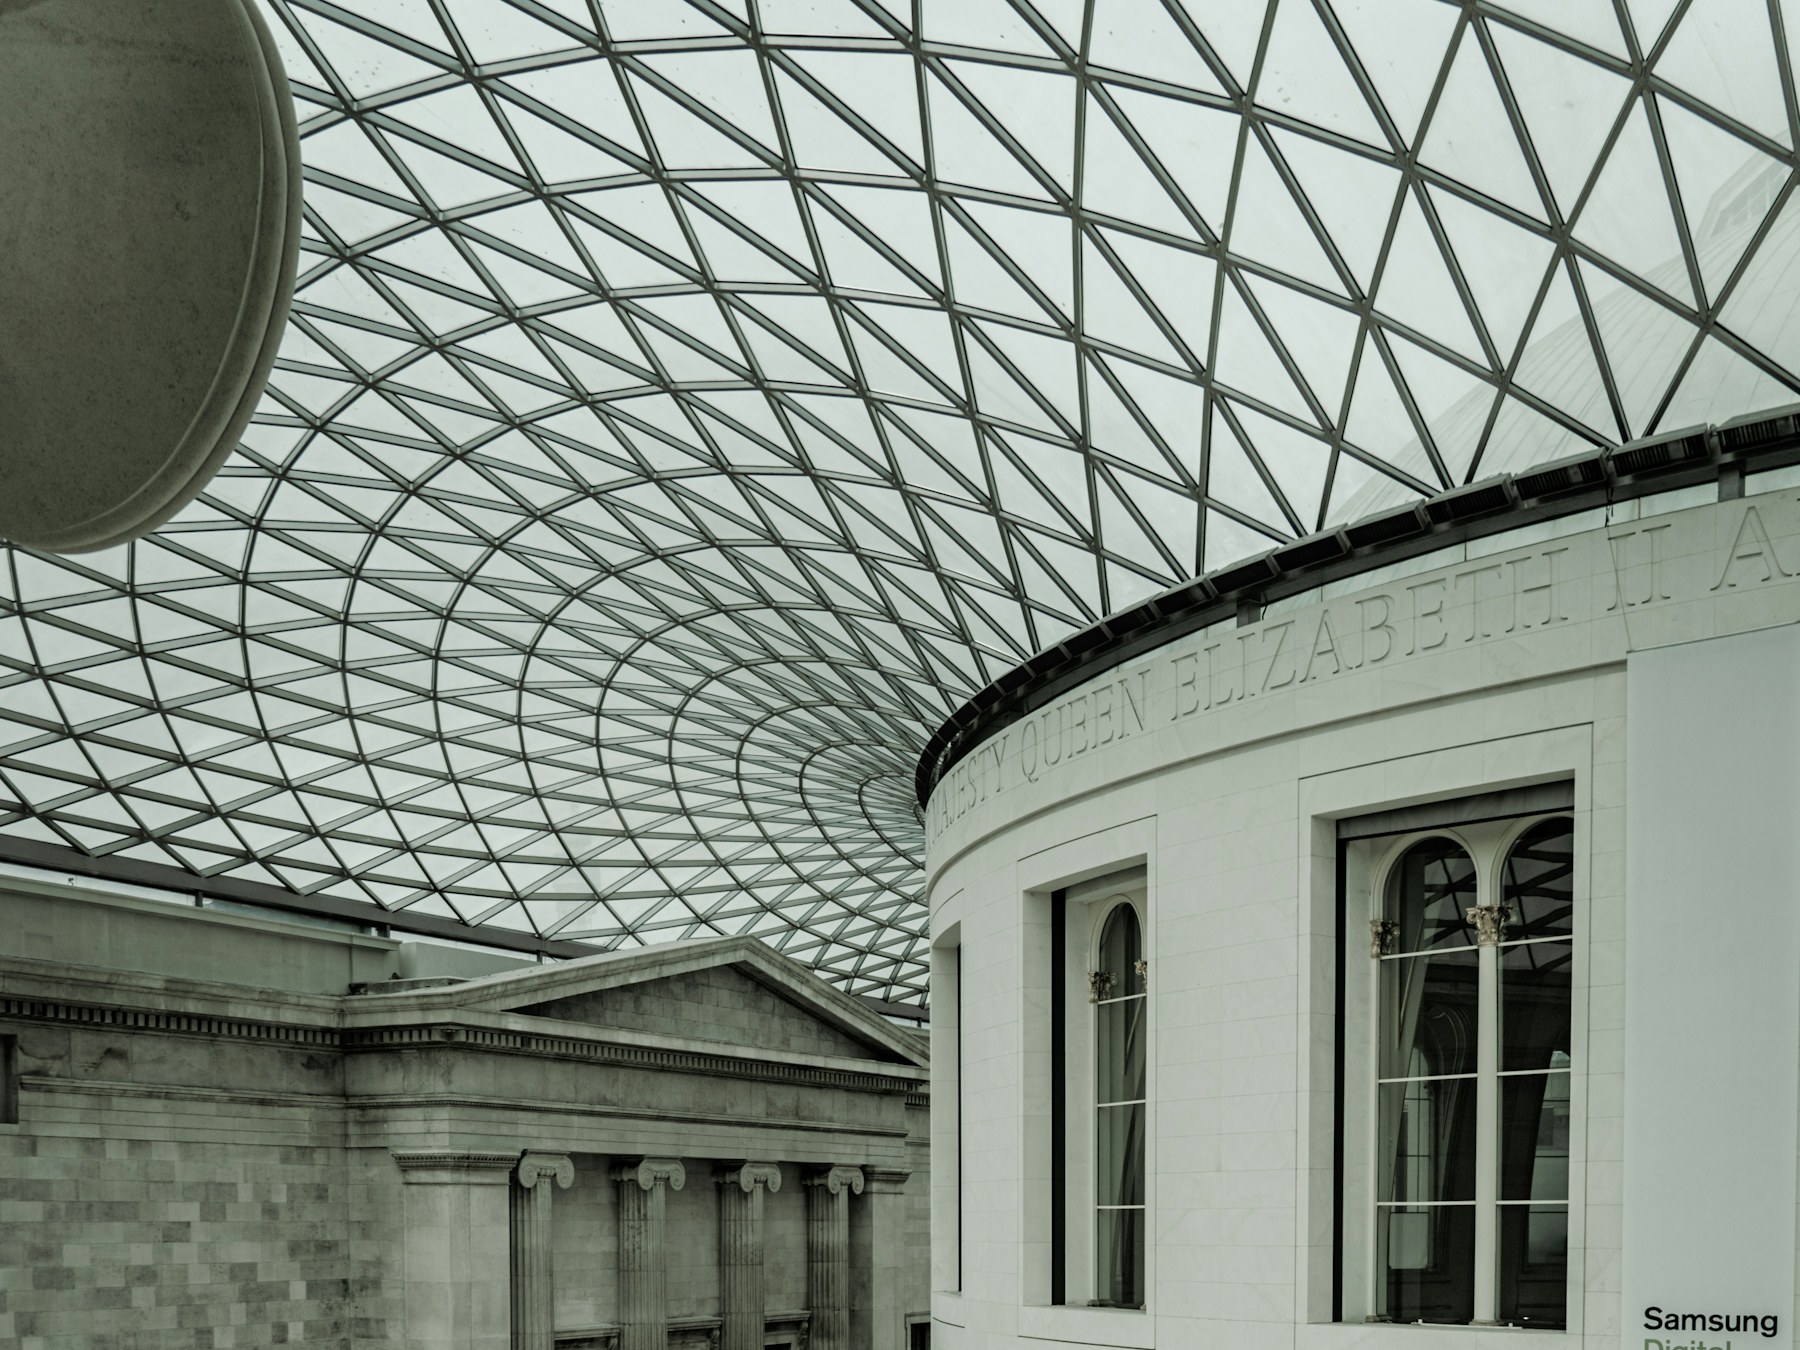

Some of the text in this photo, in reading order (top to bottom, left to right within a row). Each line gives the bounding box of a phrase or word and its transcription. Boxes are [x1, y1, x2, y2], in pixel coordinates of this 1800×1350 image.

[1021, 669, 1151, 783] QUEEN
[1171, 547, 1569, 721] ELIZABETH
[1606, 524, 1671, 612] II
[1709, 498, 1800, 591] A
[1644, 1306, 1778, 1338] Samsung
